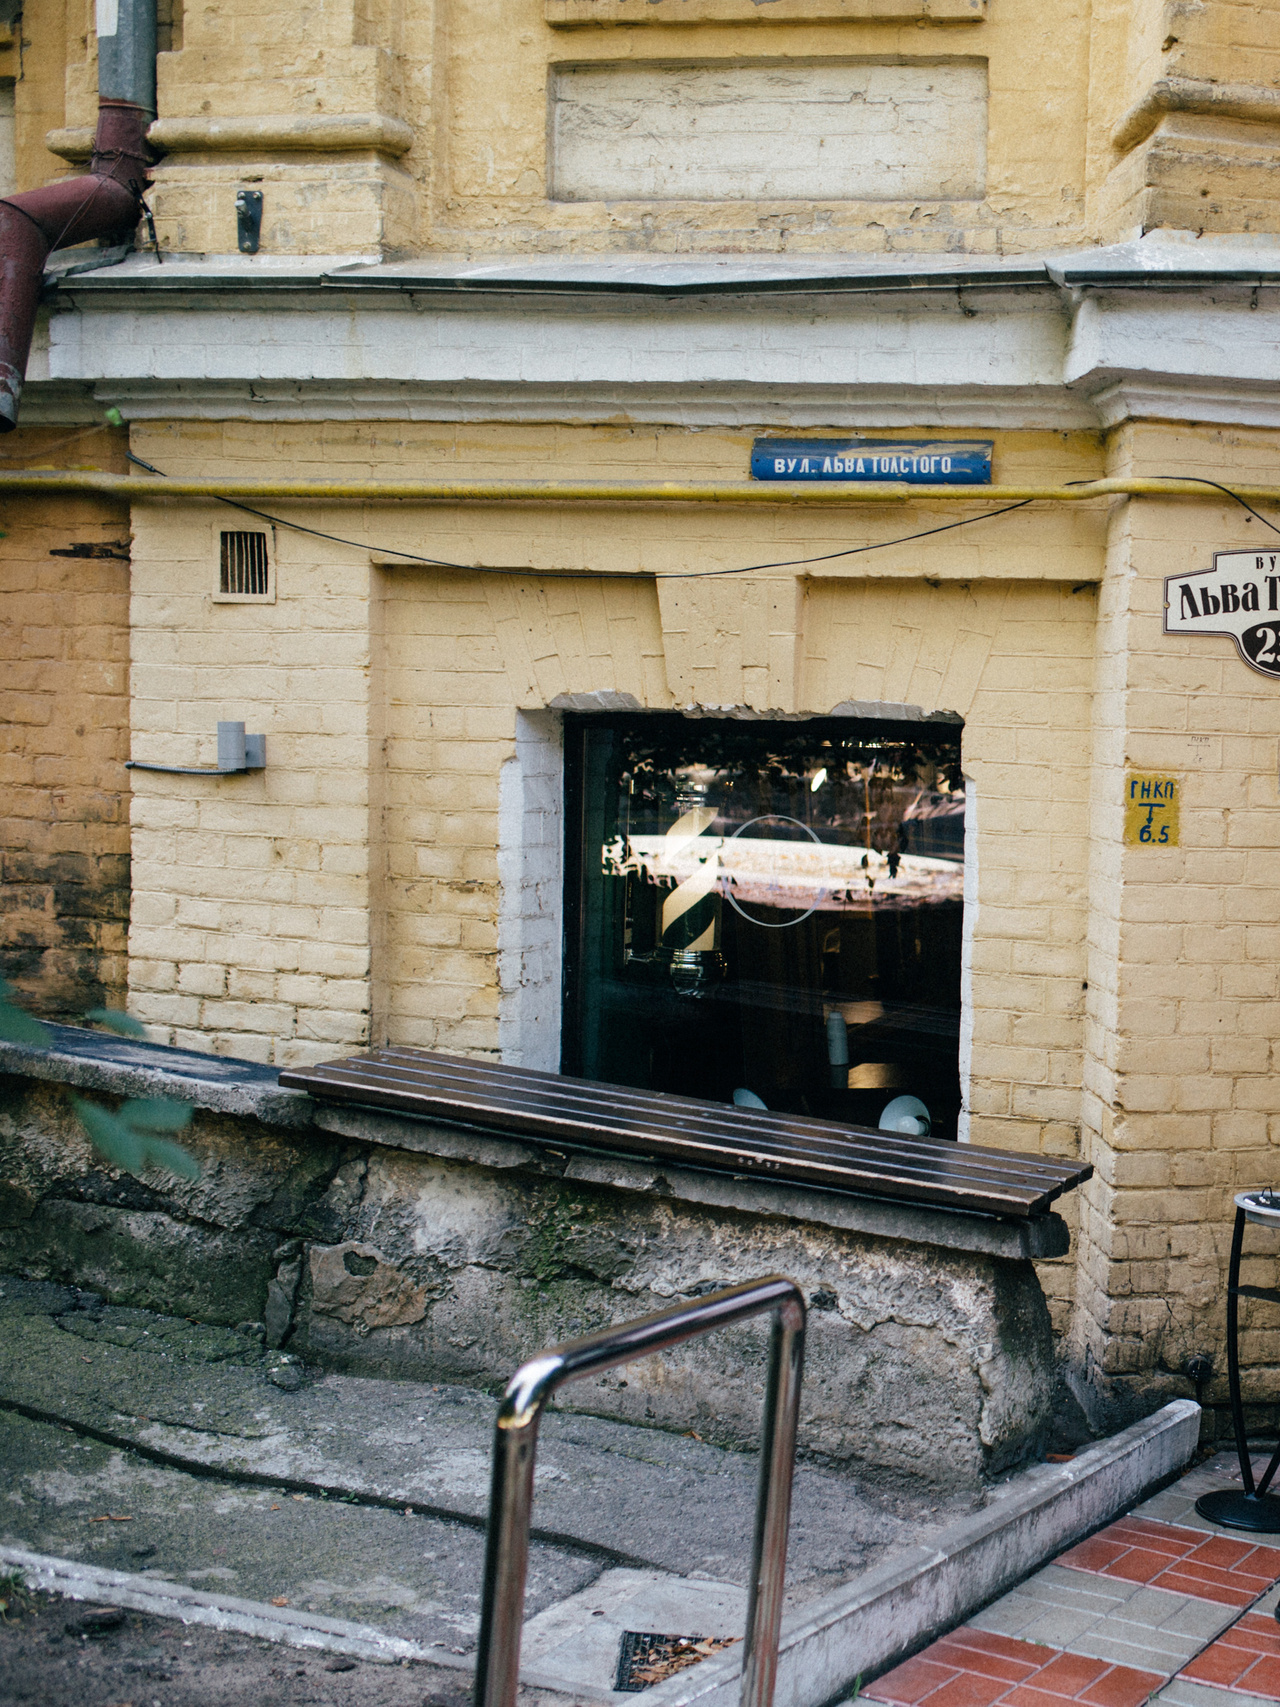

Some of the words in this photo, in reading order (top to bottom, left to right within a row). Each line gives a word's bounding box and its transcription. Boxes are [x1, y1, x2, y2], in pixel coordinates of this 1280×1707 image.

[774, 457, 816, 474] ВУЛ.
[822, 457, 866, 474] ЛЬВА
[872, 456, 952, 474] ТОЛСТОГО
[1178, 582, 1260, 621] Льва
